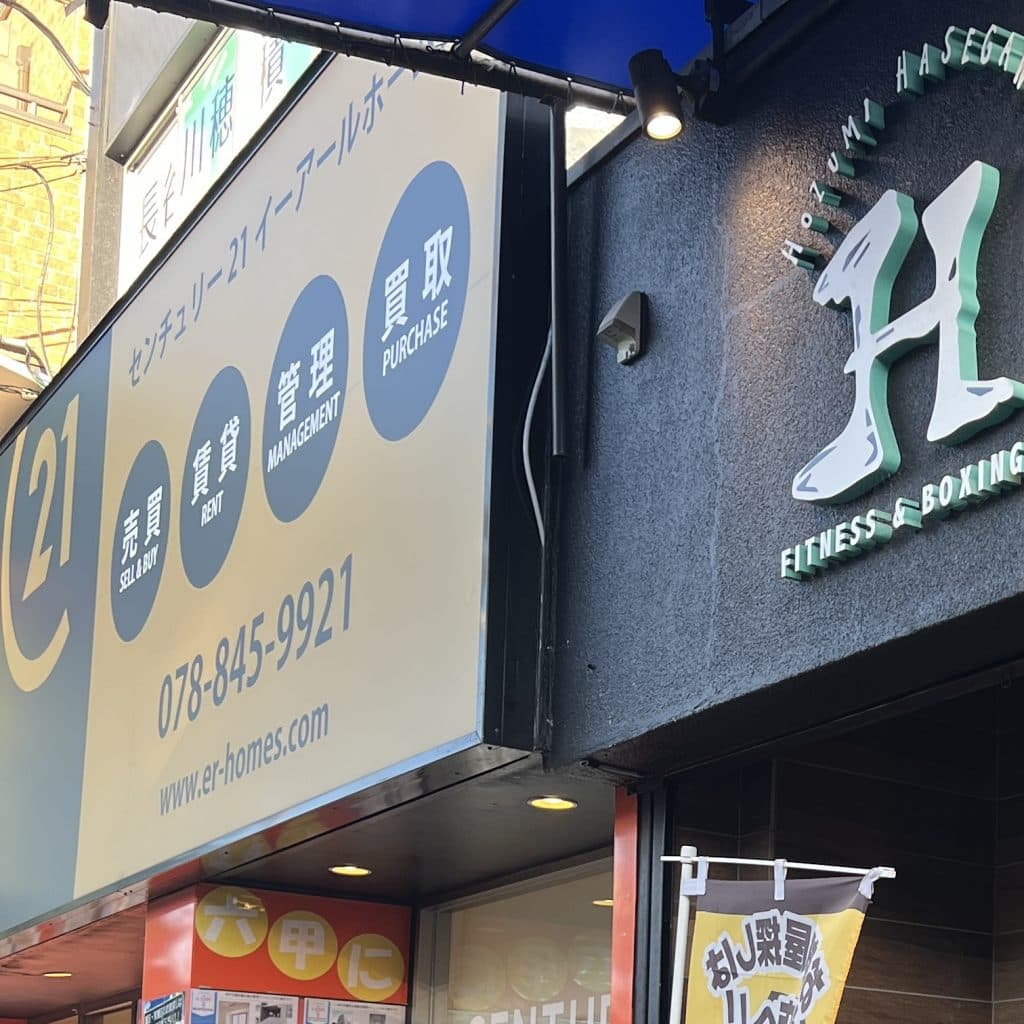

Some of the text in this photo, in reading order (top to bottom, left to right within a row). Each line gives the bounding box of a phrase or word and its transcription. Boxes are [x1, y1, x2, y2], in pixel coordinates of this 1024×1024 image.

[255, 66, 419, 252] イーアールホー
[381, 224, 455, 341] 買取
[276, 327, 336, 432] 管理
[381, 300, 449, 377] PURCHASE
[191, 415, 240, 507] 賃貸
[266, 391, 341, 473] MANAGEMENT
[120, 485, 163, 566] 売買
[200, 490, 224, 527] RENT
[780, 508, 886, 580] FITNESS
[892, 497, 914, 530] &
[119, 543, 159, 593] SELL & BUY
[158, 552, 354, 740] 078-845-9921
[159, 702, 329, 817] www.er-homes.com
[203, 895, 392, 989] 六甲に
